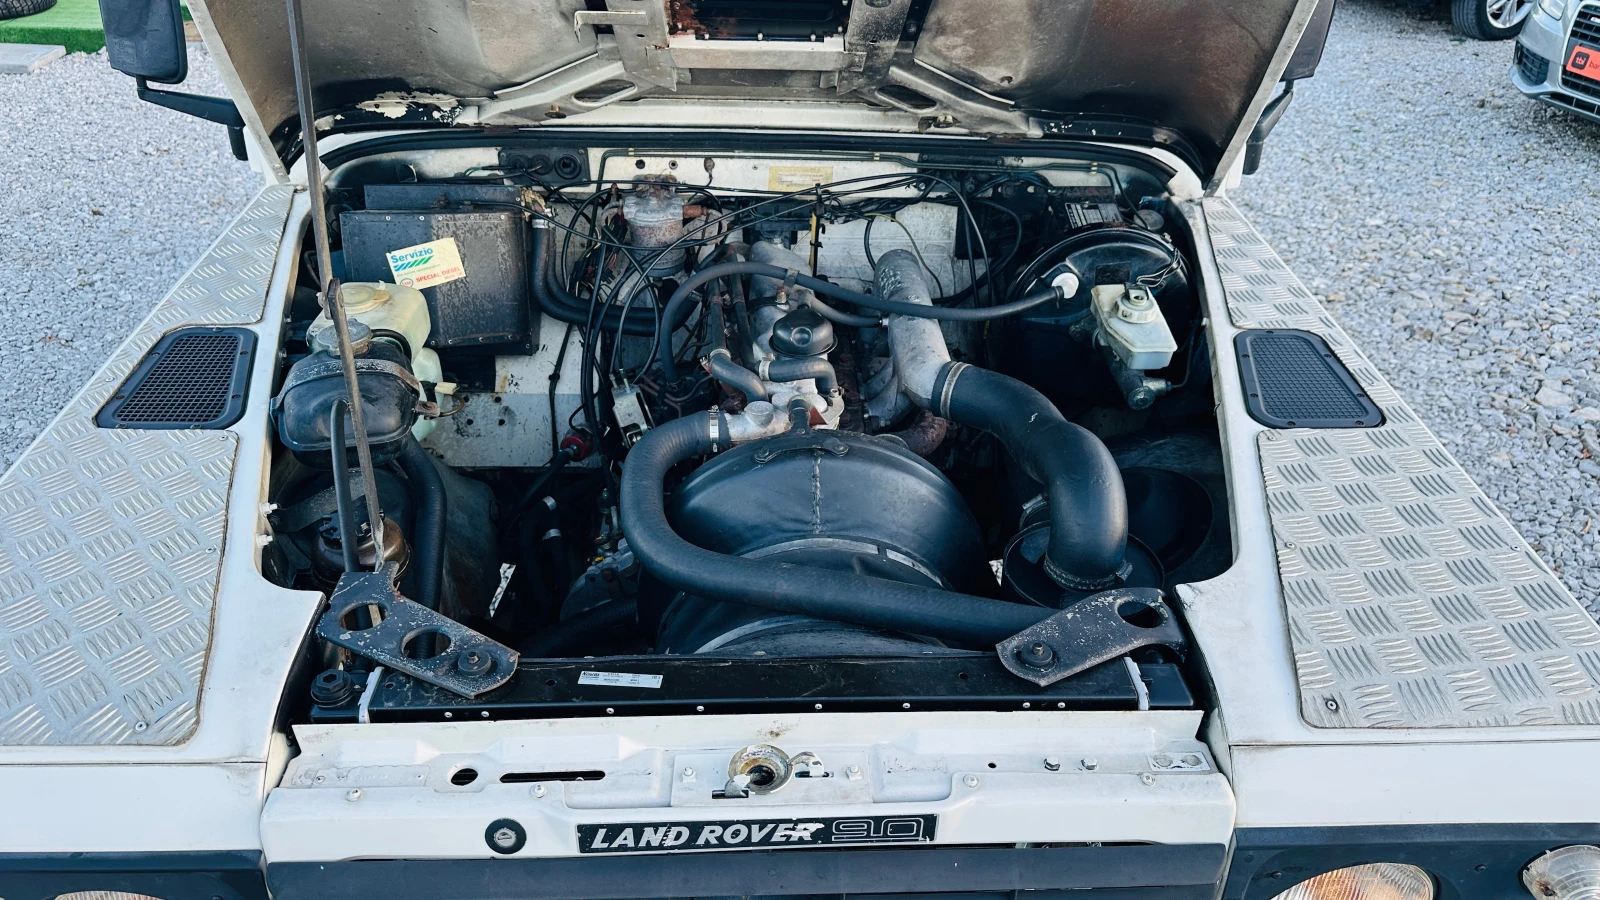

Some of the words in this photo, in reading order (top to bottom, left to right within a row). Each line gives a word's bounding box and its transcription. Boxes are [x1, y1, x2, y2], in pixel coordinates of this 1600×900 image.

[391, 247, 433, 263] Servizio
[416, 273, 440, 282] SPECIAL
[441, 267, 460, 275] DIESEL
[590, 824, 690, 849] LAND
[695, 822, 825, 845] ROVER
[831, 818, 924, 842] 90
